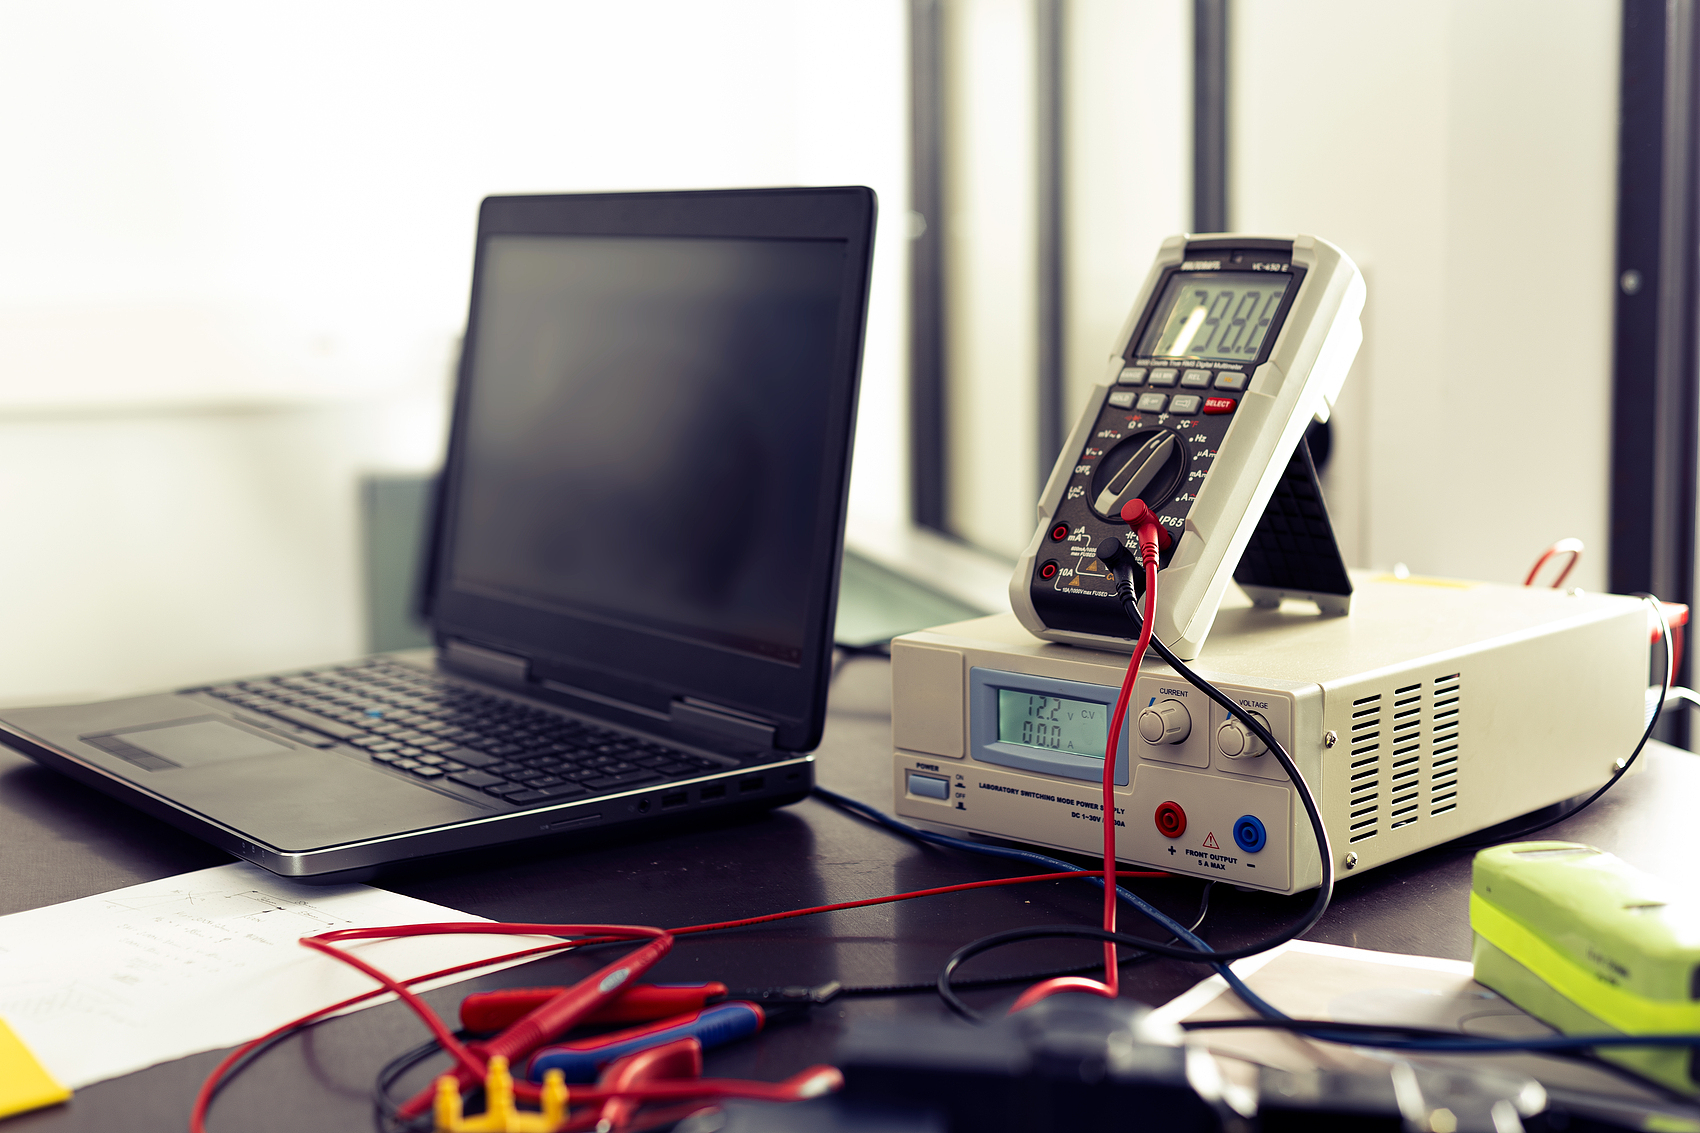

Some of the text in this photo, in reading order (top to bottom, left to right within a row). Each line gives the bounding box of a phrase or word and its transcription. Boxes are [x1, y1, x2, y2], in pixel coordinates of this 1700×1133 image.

[1187, 373, 1201, 381] REL
[1205, 399, 1231, 408] SELECT
[1194, 433, 1207, 443] Hz
[1075, 464, 1091, 474] OFF
[1159, 515, 1185, 528] IP65
[1067, 534, 1082, 542] mA
[1125, 539, 1138, 549] Hz
[1059, 567, 1074, 577] 10A
[1091, 590, 1108, 598] FUSED
[1159, 687, 1189, 698] CURRENT
[1028, 695, 1062, 722] 12.2
[1067, 712, 1074, 721] V
[1238, 699, 1269, 710] VOLTAGE
[1022, 720, 1074, 750] 00.0 A
[916, 762, 940, 772] POWER
[955, 773, 964, 781] ON
[955, 792, 966, 800] OFF
[978, 782, 1126, 815] LABORATORY SWITCHING MODE POWER SPLY
[1071, 811, 1081, 819] DC
[1185, 848, 1238, 865] FRONT OUTPUT
[1210, 861, 1226, 870] MAX
